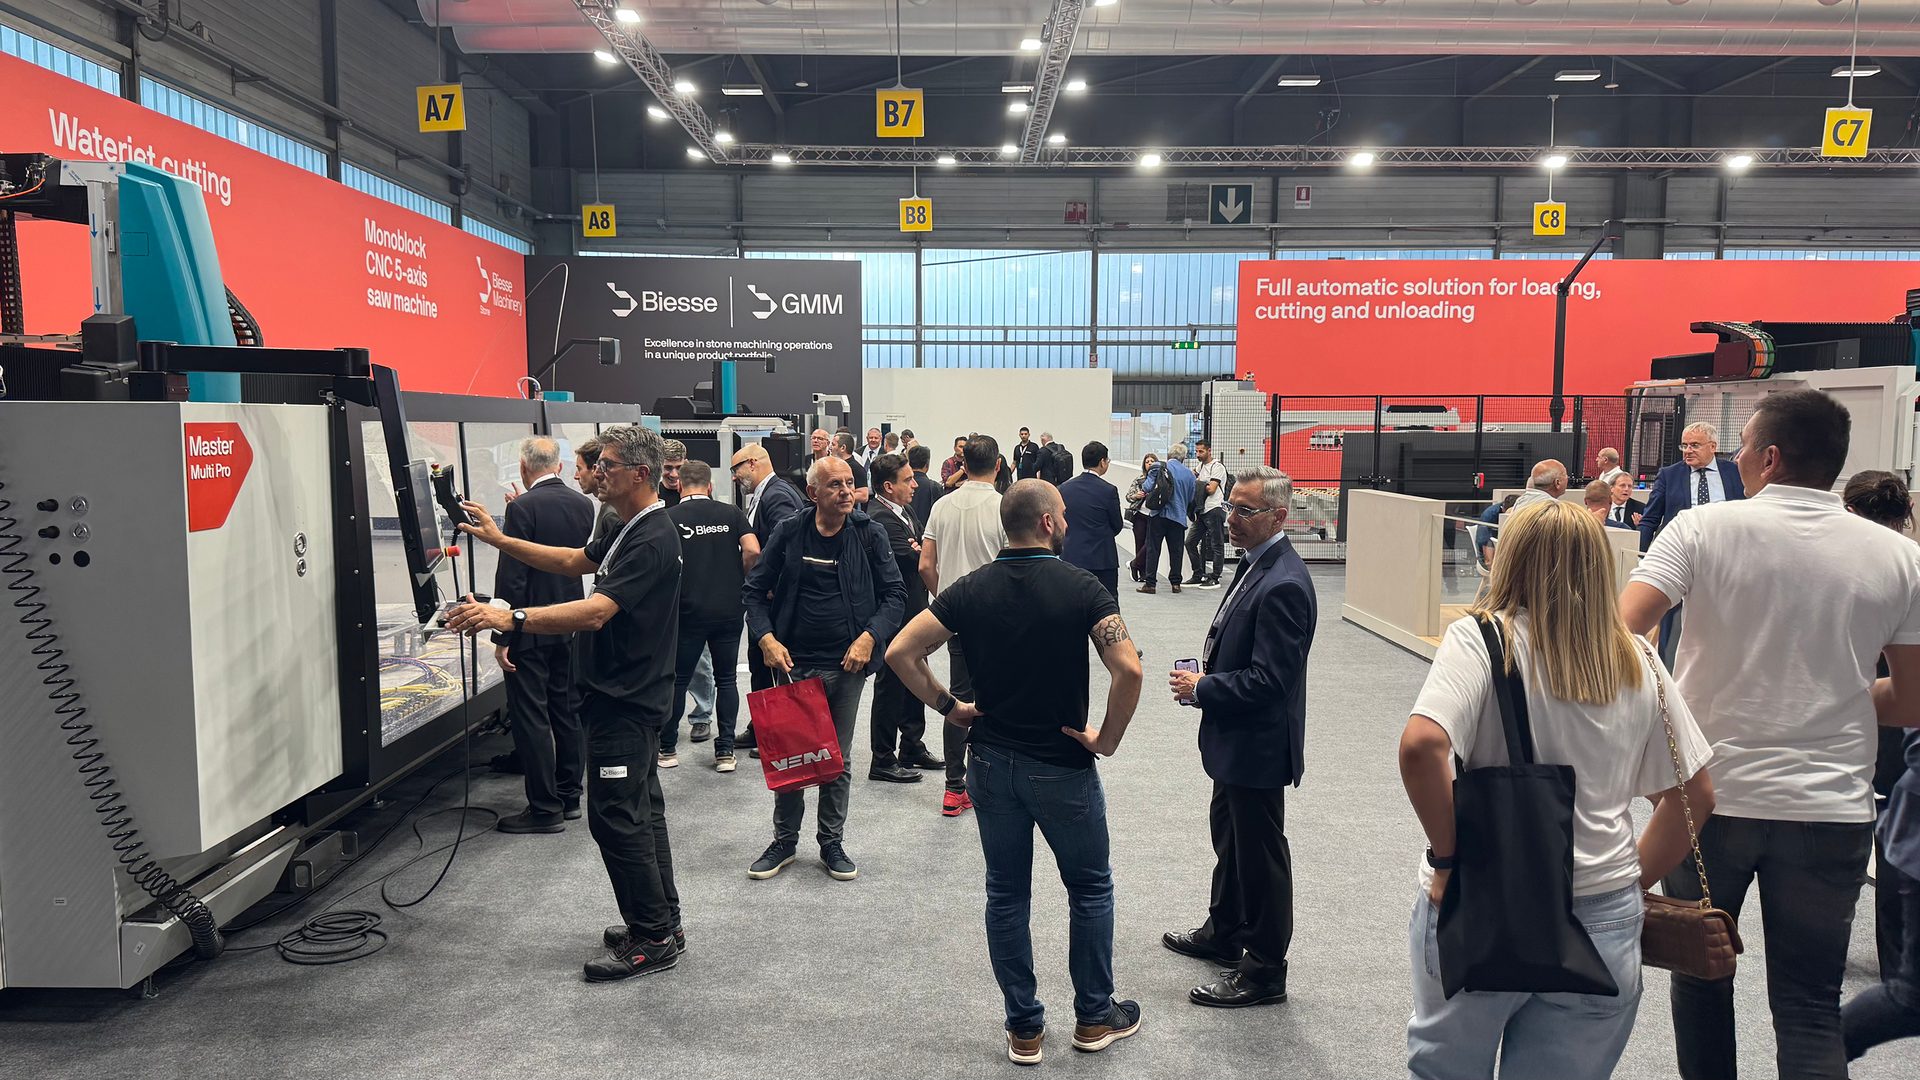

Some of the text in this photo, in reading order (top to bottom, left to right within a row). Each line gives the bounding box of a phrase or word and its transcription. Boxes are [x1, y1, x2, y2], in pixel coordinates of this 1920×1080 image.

[425, 93, 455, 122] A7
[884, 99, 915, 127] B7
[1832, 118, 1864, 147] C7
[588, 210, 610, 230] A8
[905, 205, 927, 225] B8
[1539, 209, 1560, 228] C8
[364, 217, 427, 260] Monoblock
[365, 249, 428, 289] CNC 5-axis
[491, 271, 513, 294] Biesse
[1256, 278, 1292, 297] Full
[1295, 279, 1399, 297] automatic
[1402, 279, 1485, 297] solution
[1488, 279, 1517, 297] for
[366, 287, 438, 319] saw machine
[491, 290, 523, 317] Machinery
[641, 290, 719, 313] Biesse
[781, 293, 844, 315] GMM
[1255, 302, 1476, 323] cutting and unloading
[644, 338, 833, 352] Excellence in stone machining operations
[644, 350, 654, 359] in
[662, 350, 696, 362] unique
[696, 351, 734, 362] product
[188, 435, 235, 457] Master
[190, 463, 231, 480] Multi Pro
[695, 524, 730, 535] Biesse
